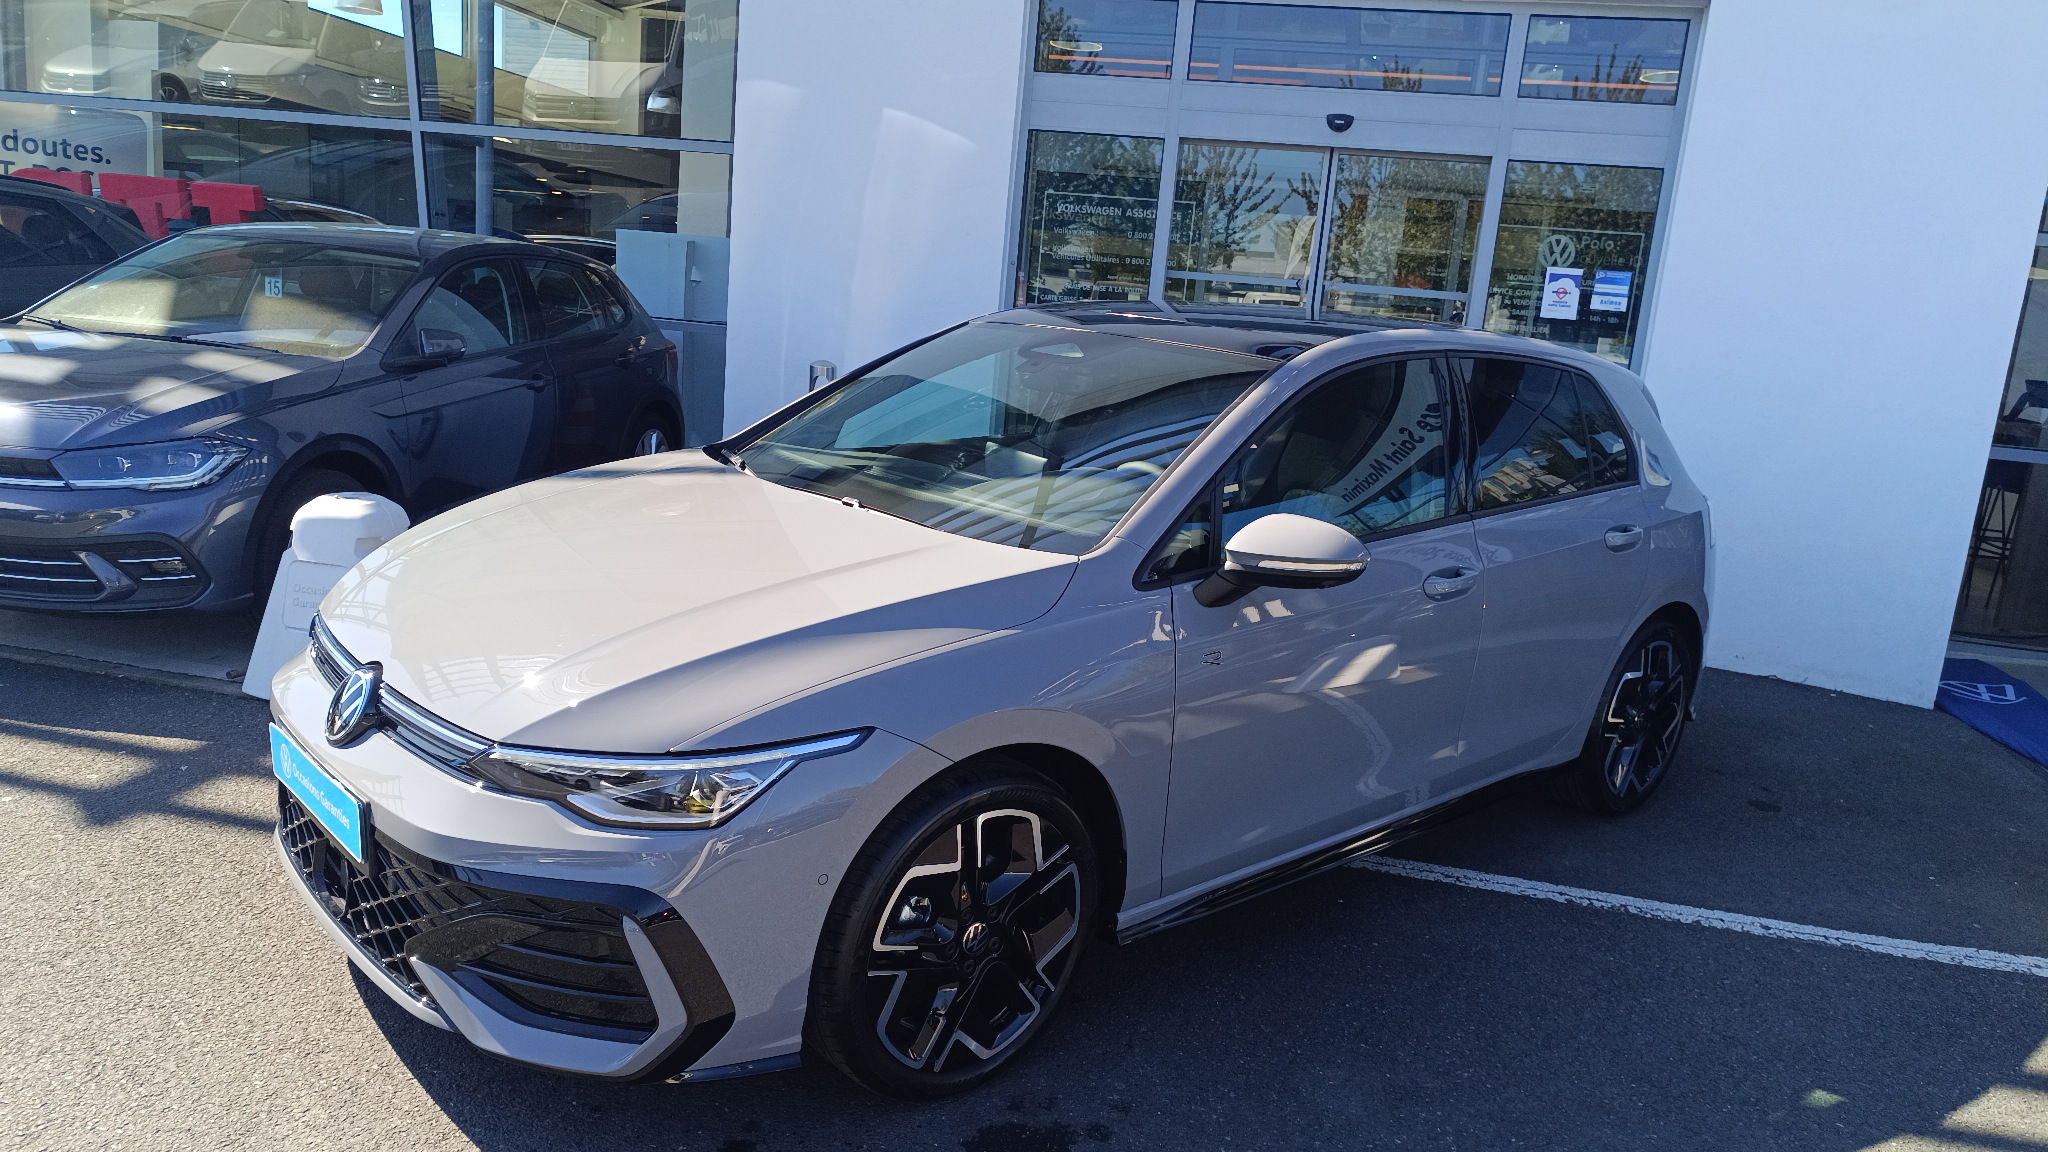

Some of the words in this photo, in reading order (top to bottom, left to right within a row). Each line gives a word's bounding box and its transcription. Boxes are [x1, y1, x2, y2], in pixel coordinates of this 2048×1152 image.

[1, 129, 112, 165] doutes.
[1057, 203, 1122, 217] VOLKSWAGEN
[268, 279, 280, 296] 15
[292, 763, 320, 801] Occasions
[319, 790, 350, 830] Garanties
